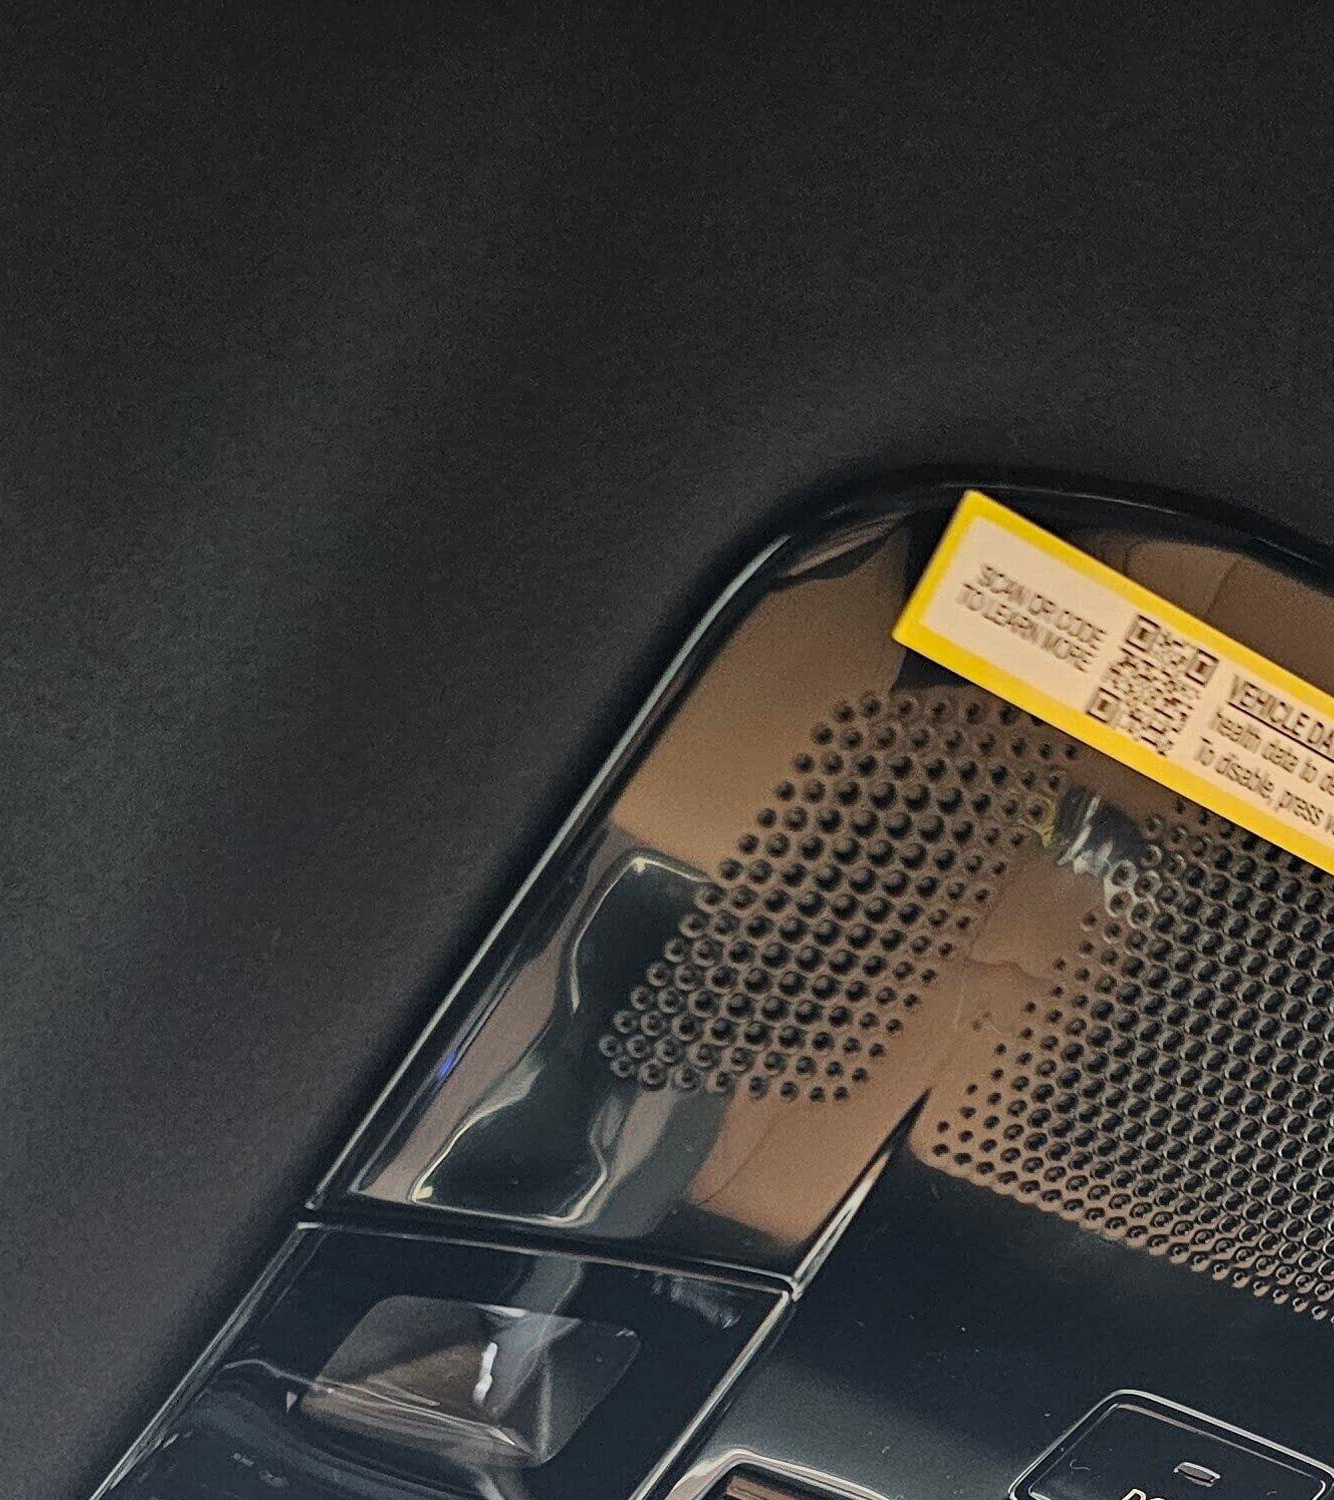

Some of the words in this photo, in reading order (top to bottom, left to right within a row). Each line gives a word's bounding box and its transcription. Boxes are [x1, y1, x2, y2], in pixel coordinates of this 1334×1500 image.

[956, 582, 985, 611] TO
[982, 598, 1042, 644] LEARN
[1039, 629, 1095, 673] MORE
[977, 564, 1029, 607] SCAN
[1055, 609, 1107, 651] CODE
[1208, 706, 1267, 754] health
[1261, 736, 1304, 774] data
[1297, 759, 1321, 785] to
[1225, 674, 1311, 737] VEHICLE
[1191, 737, 1219, 767] To
[1212, 749, 1280, 805] disable,
[1273, 788, 1325, 831] press
